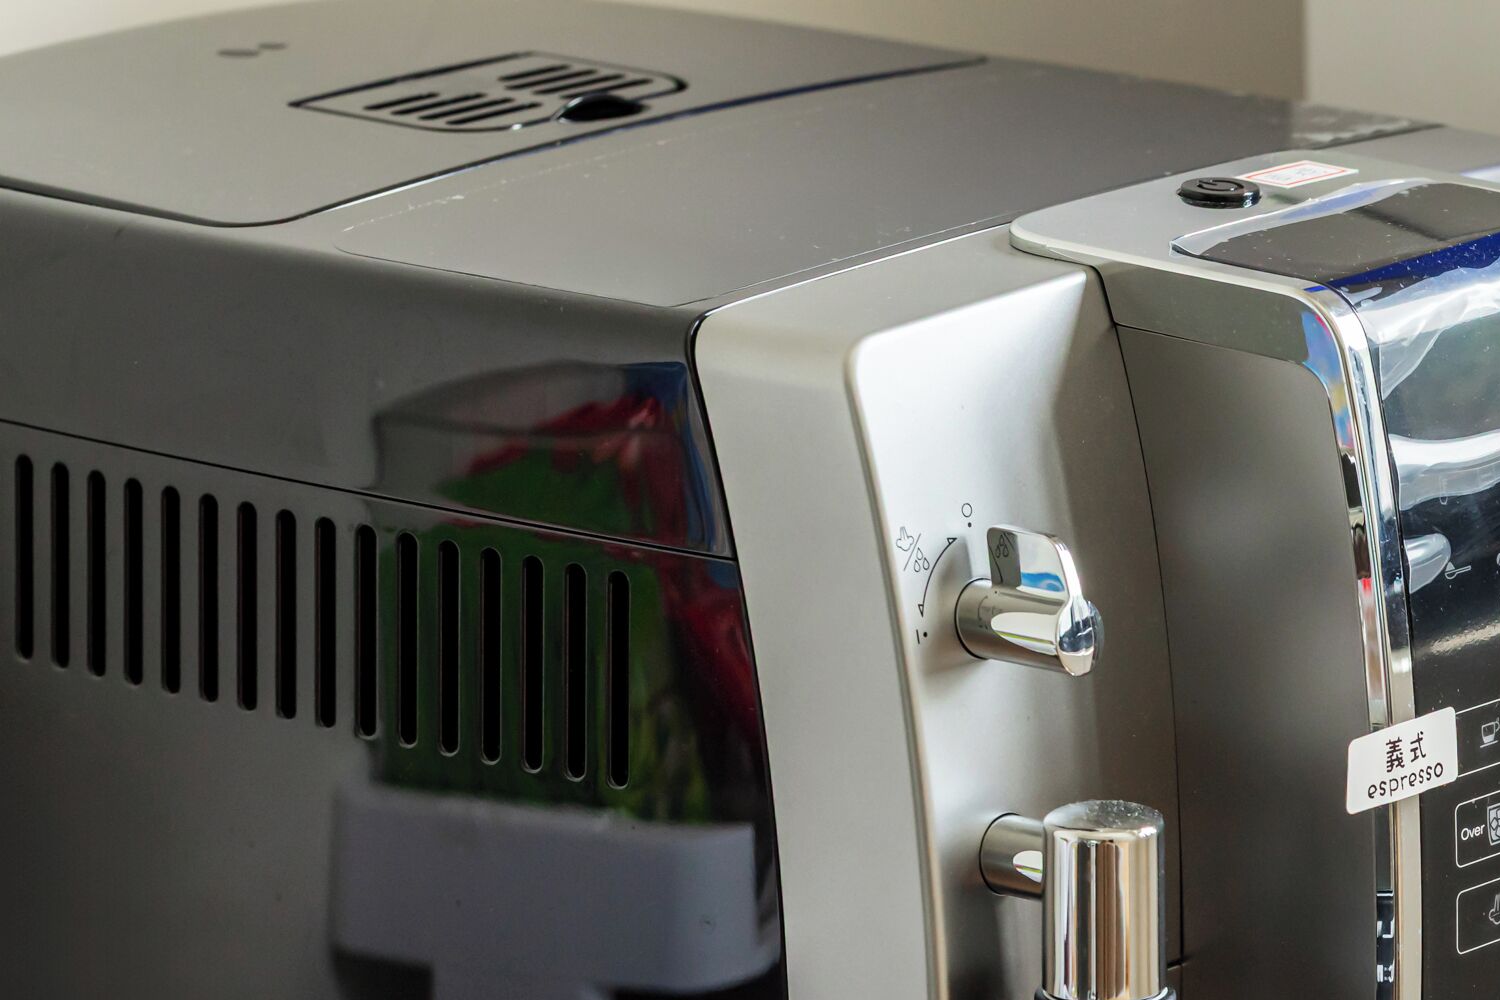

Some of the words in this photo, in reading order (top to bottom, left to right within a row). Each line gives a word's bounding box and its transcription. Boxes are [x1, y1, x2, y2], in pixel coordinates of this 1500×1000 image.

[1385, 731, 1427, 773] 義式
[1367, 762, 1444, 799] espresso
[1460, 823, 1486, 841] Over
